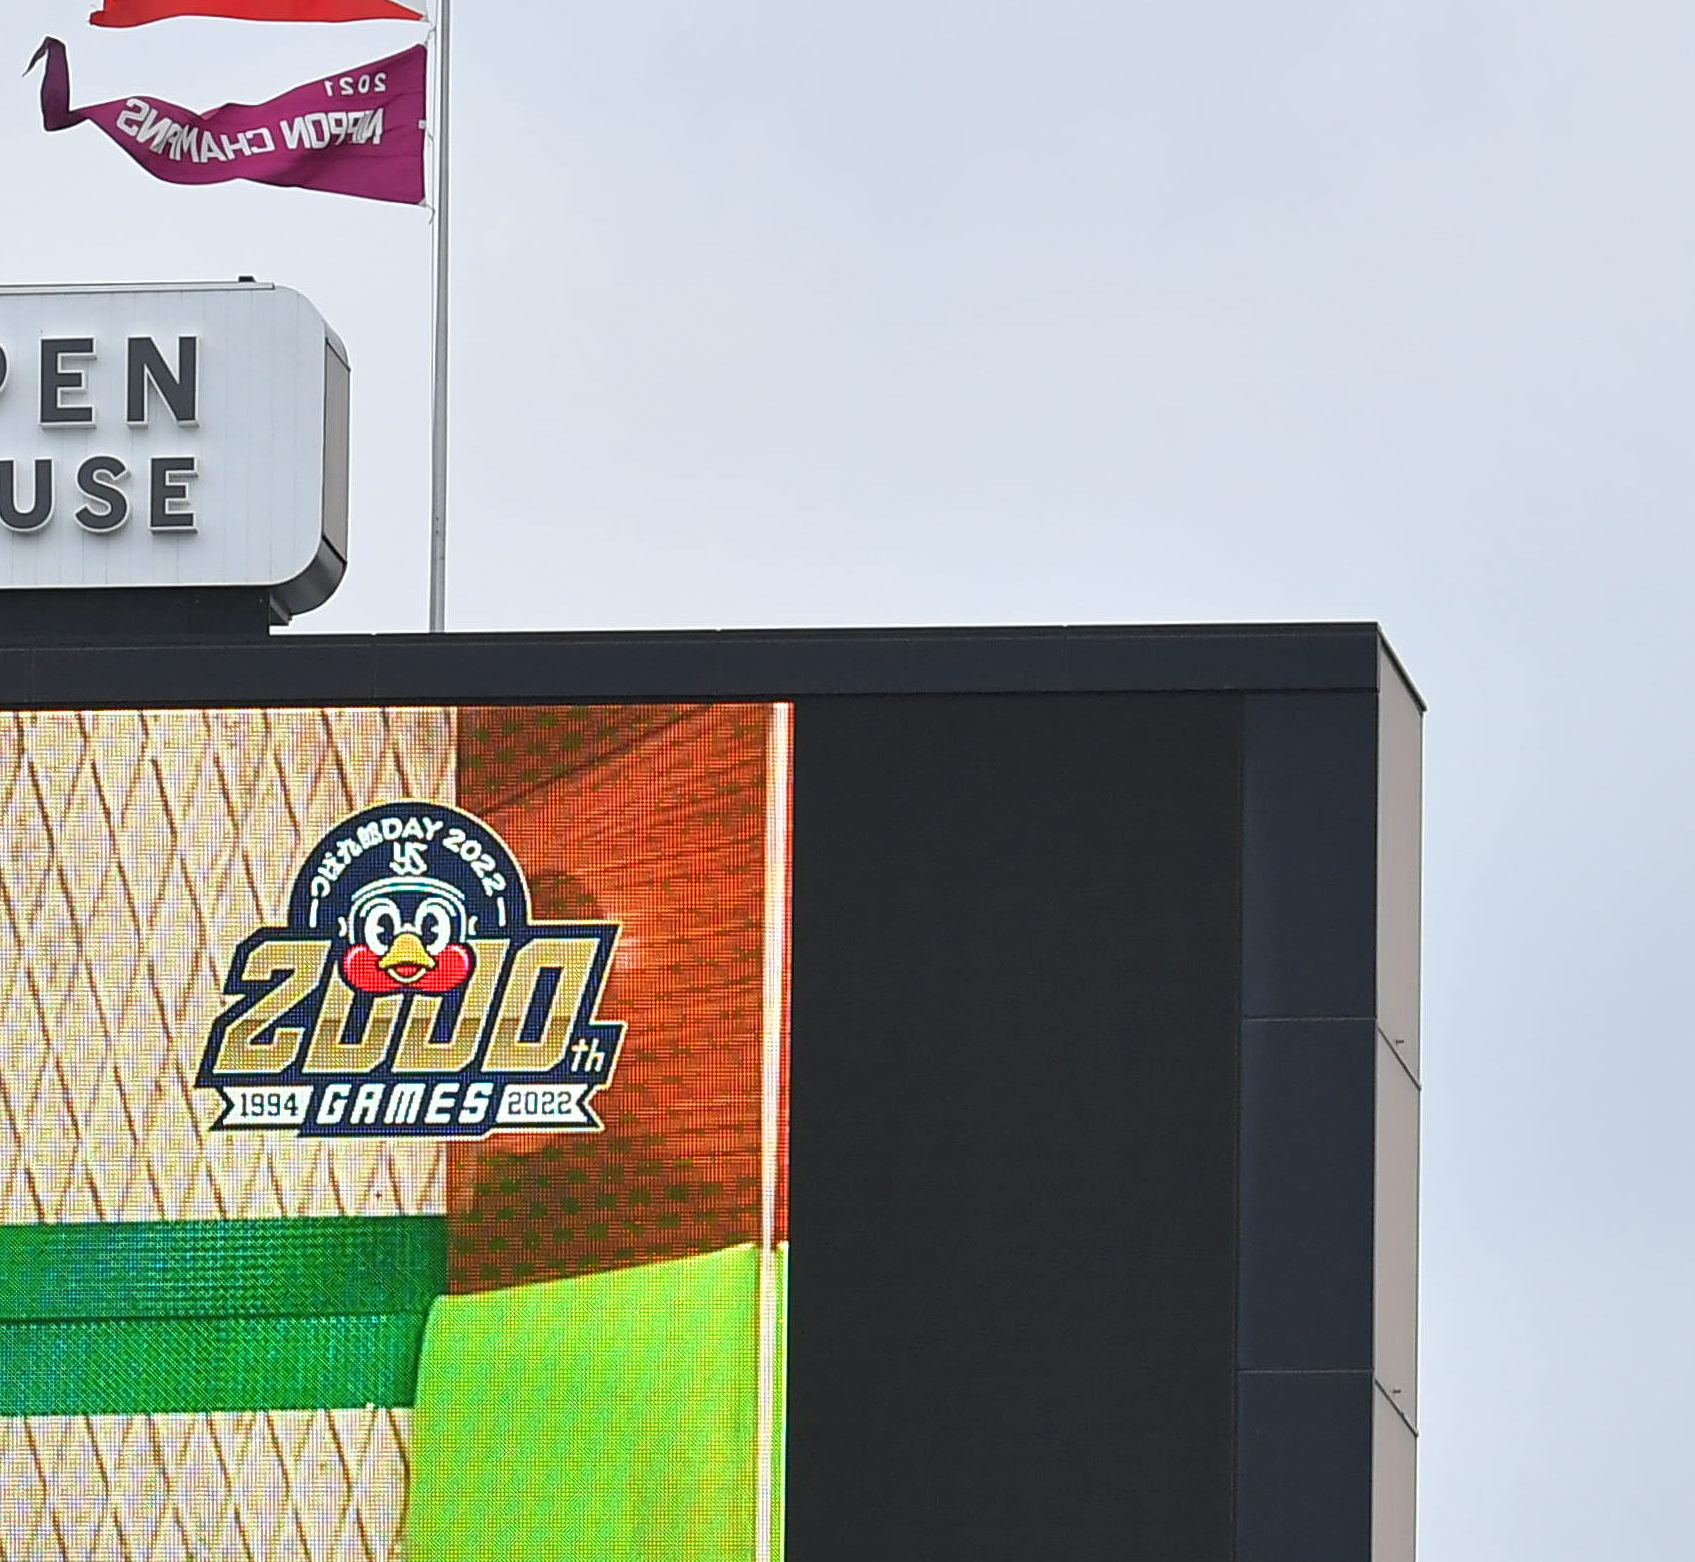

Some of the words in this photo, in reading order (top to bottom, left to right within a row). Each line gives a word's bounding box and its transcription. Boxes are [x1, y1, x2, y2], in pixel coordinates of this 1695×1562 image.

[442, 828, 507, 897] 2022
[239, 1090, 299, 1118] 1994
[316, 1083, 495, 1124] GAMES
[508, 1090, 574, 1116] 2022
